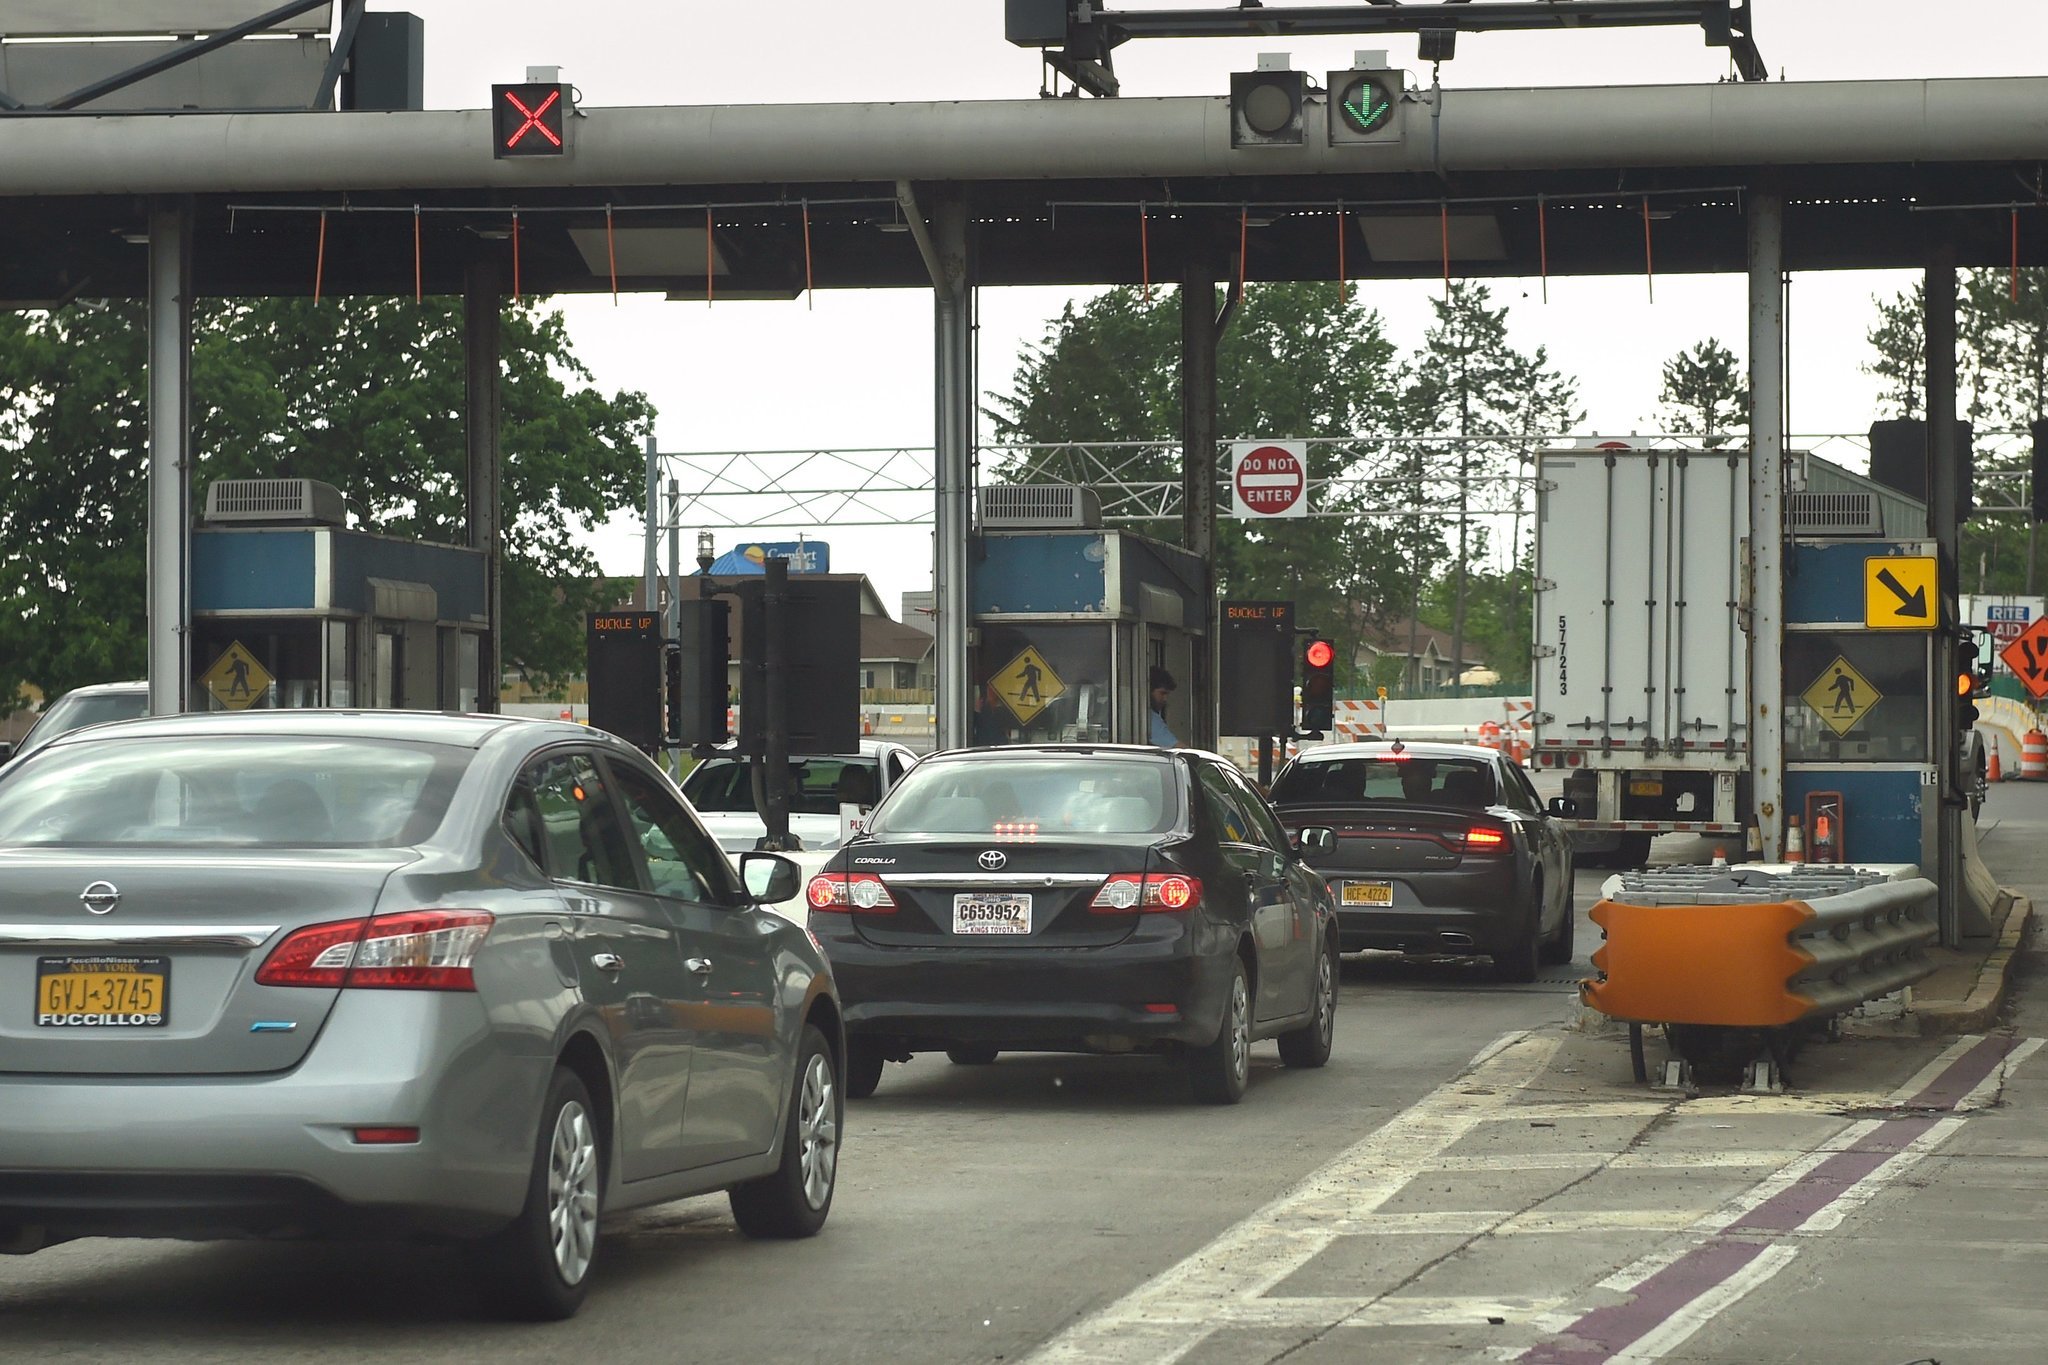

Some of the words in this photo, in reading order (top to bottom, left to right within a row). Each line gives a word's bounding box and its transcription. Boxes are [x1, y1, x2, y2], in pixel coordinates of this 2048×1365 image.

[1243, 458, 1262, 471] DO
[1268, 458, 1295, 471] NOT
[1247, 489, 1292, 502] ENTER
[1228, 607, 1266, 618] BUCKLE
[1272, 607, 1285, 618] UP
[1992, 607, 2024, 620] RITE
[595, 618, 632, 630] BUCKLE
[638, 617, 652, 629] UP
[1994, 623, 2022, 637] AID
[1559, 615, 1568, 696] 577243
[854, 857, 897, 865] COROLLA
[990, 926, 1014, 934] TOYOTA
[70, 963, 100, 973] NEW
[105, 963, 137, 973] YORK
[39, 1013, 146, 1026] FUCCILLO
